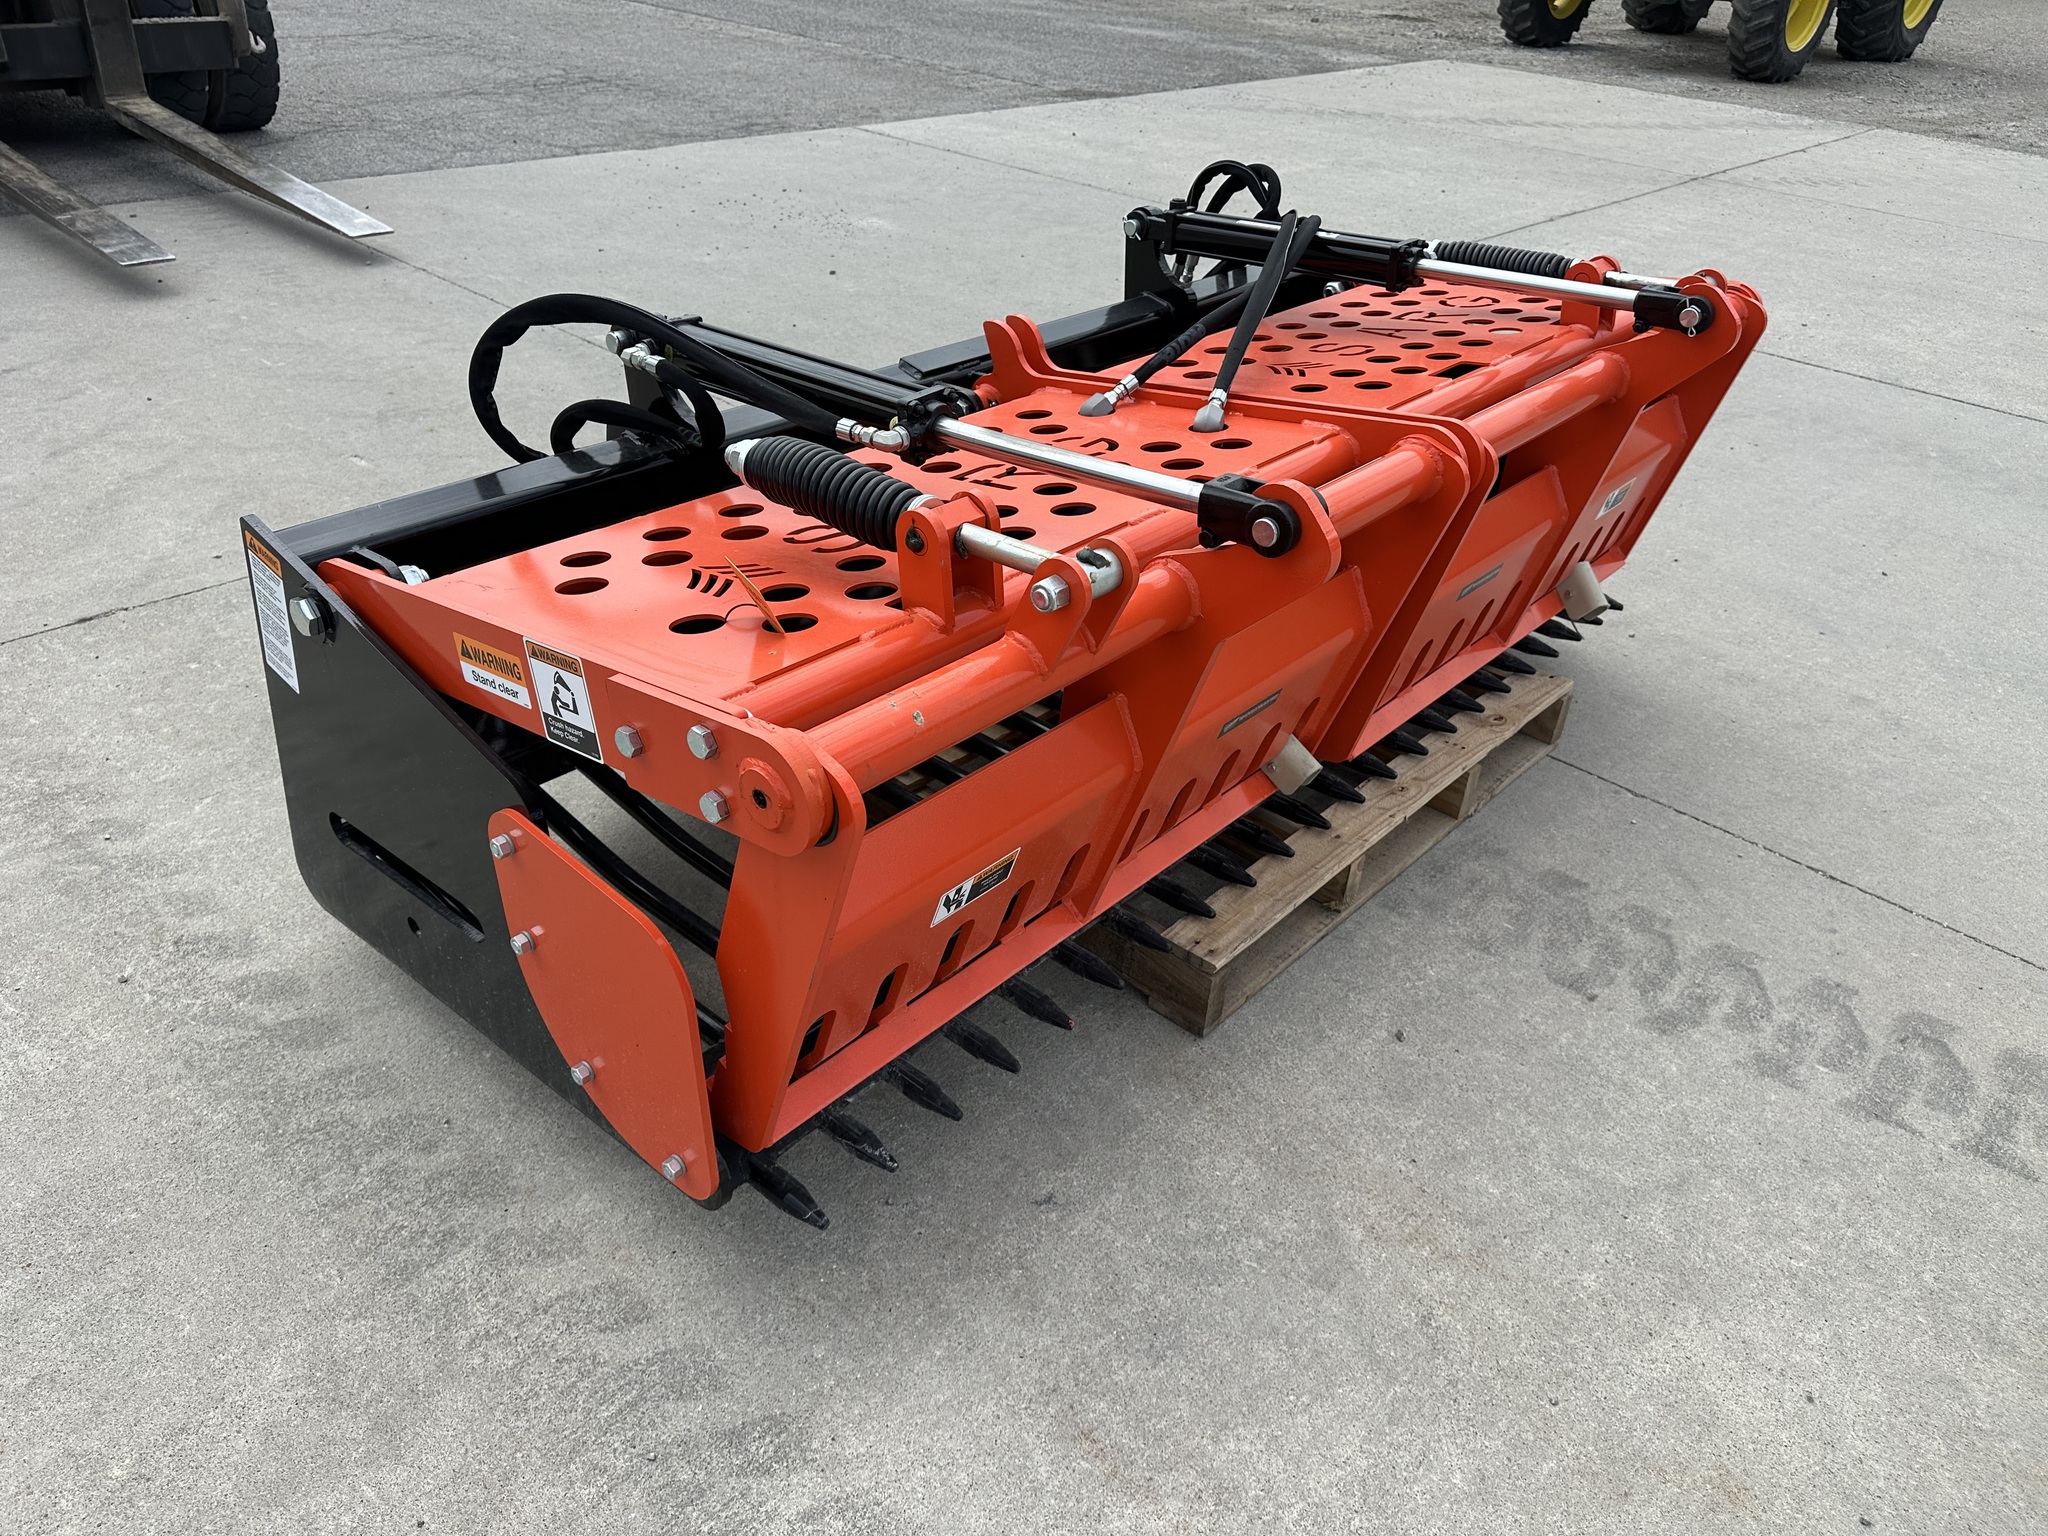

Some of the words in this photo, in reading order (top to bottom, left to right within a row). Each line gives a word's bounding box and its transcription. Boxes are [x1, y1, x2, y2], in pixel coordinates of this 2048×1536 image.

[1308, 295, 1501, 357] SARG
[470, 645, 523, 682] WARNING
[537, 647, 578, 674] WARNING
[471, 669, 497, 690] Stand
[497, 682, 520, 700] clear
[548, 717, 565, 730] Crush
[550, 726, 565, 739] Keep
